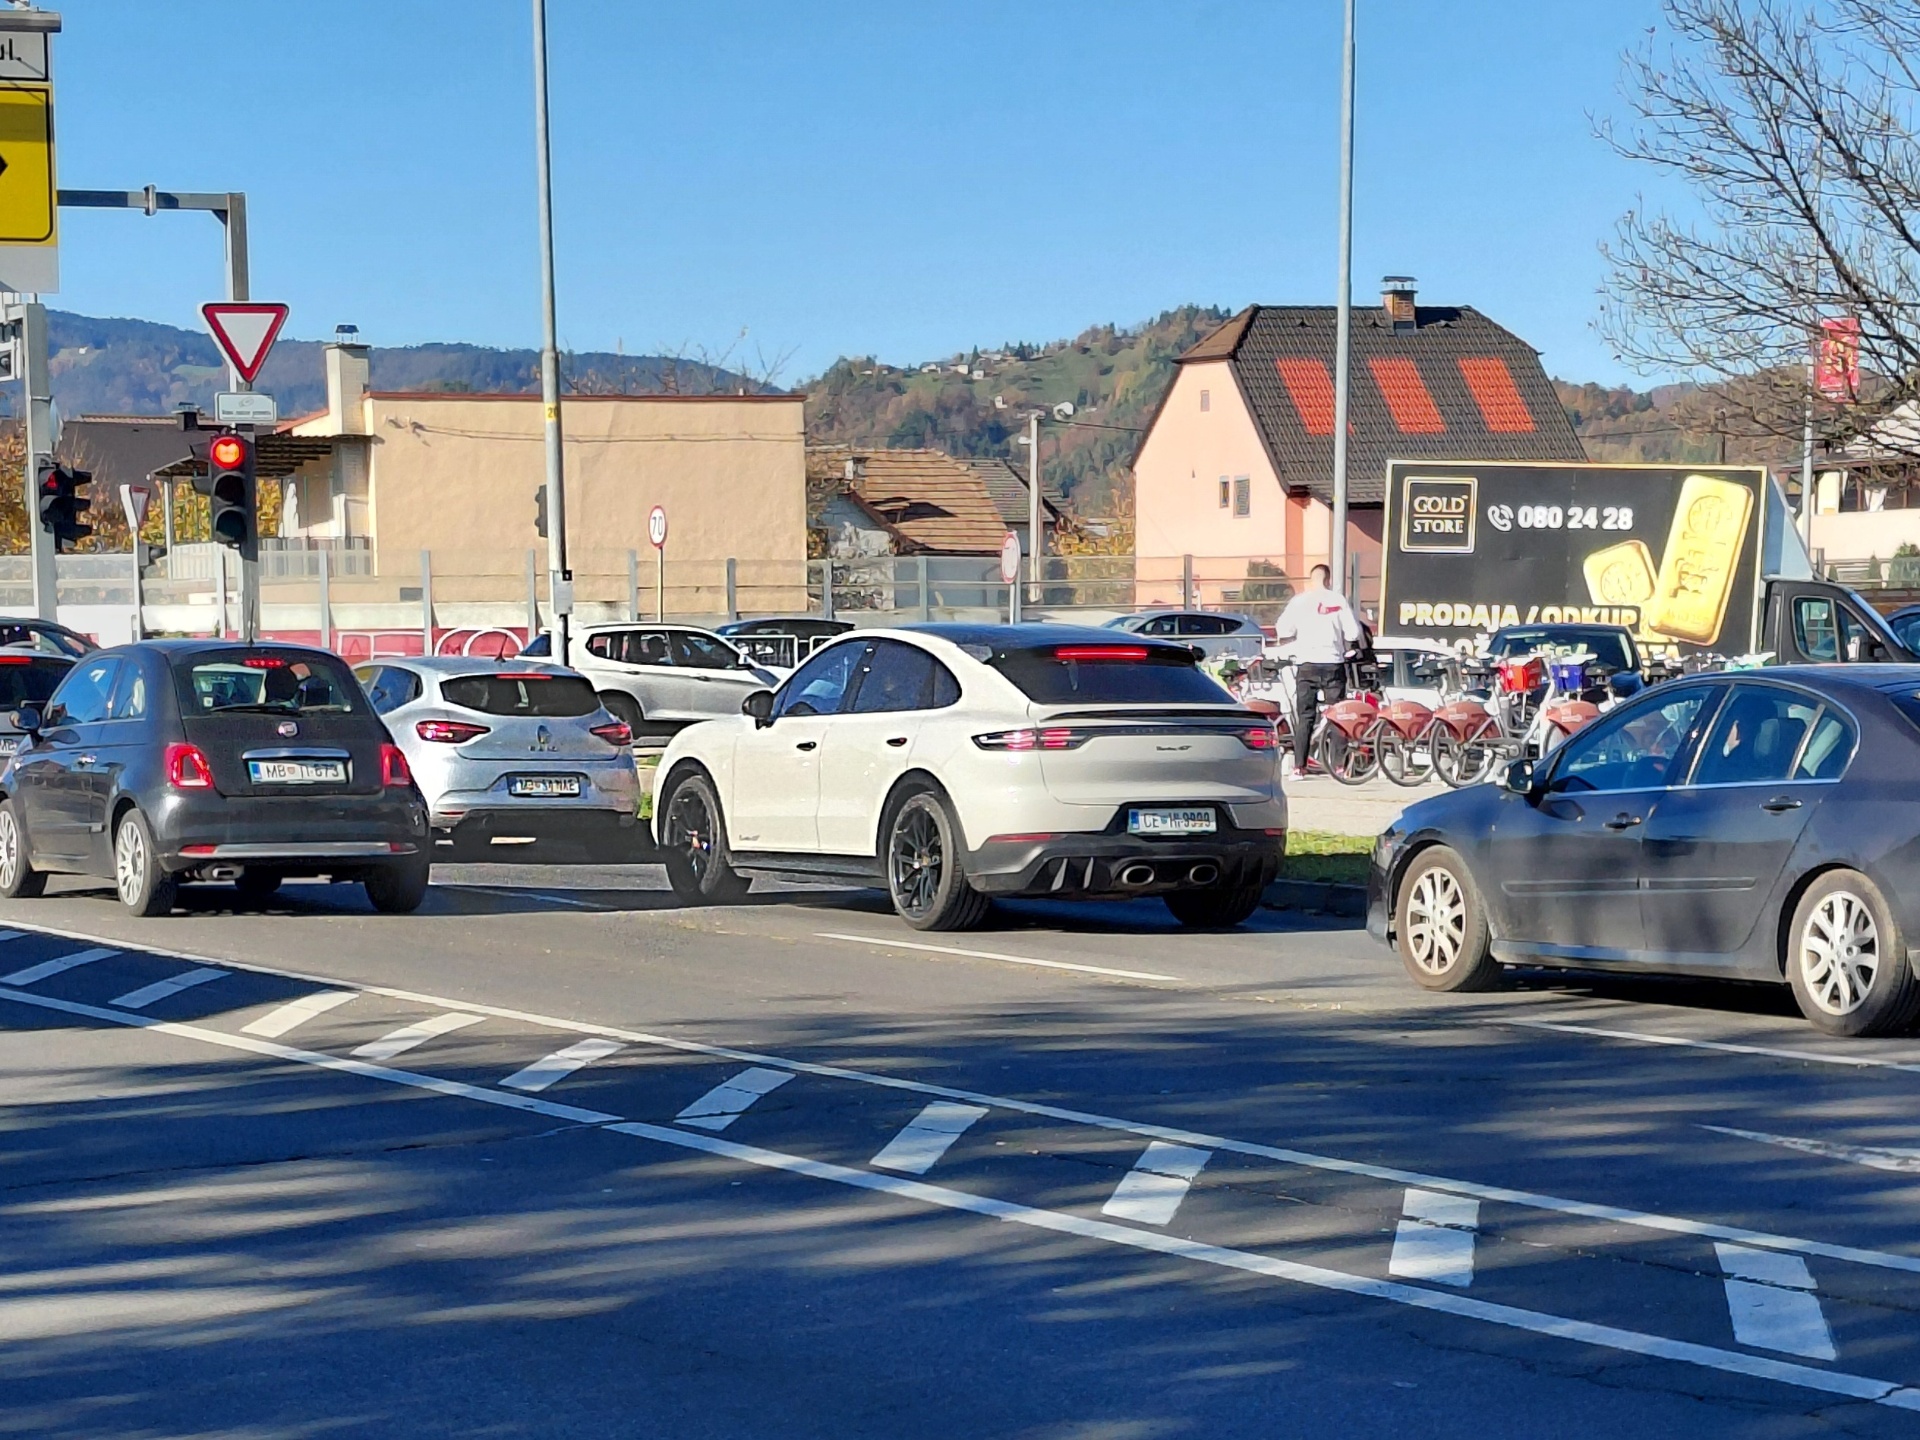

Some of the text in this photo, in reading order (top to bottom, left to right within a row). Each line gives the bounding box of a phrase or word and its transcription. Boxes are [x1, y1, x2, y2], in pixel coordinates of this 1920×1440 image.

[1413, 495, 1465, 513] GOLD
[651, 515, 663, 537] 70
[1413, 519, 1464, 533] STORE
[1517, 505, 1634, 531] 080 24 28
[1399, 602, 1521, 633] PRODAJA
[1540, 606, 1639, 626] ODKUP
[265, 764, 287, 779] MB
[1143, 812, 1160, 828] CE
